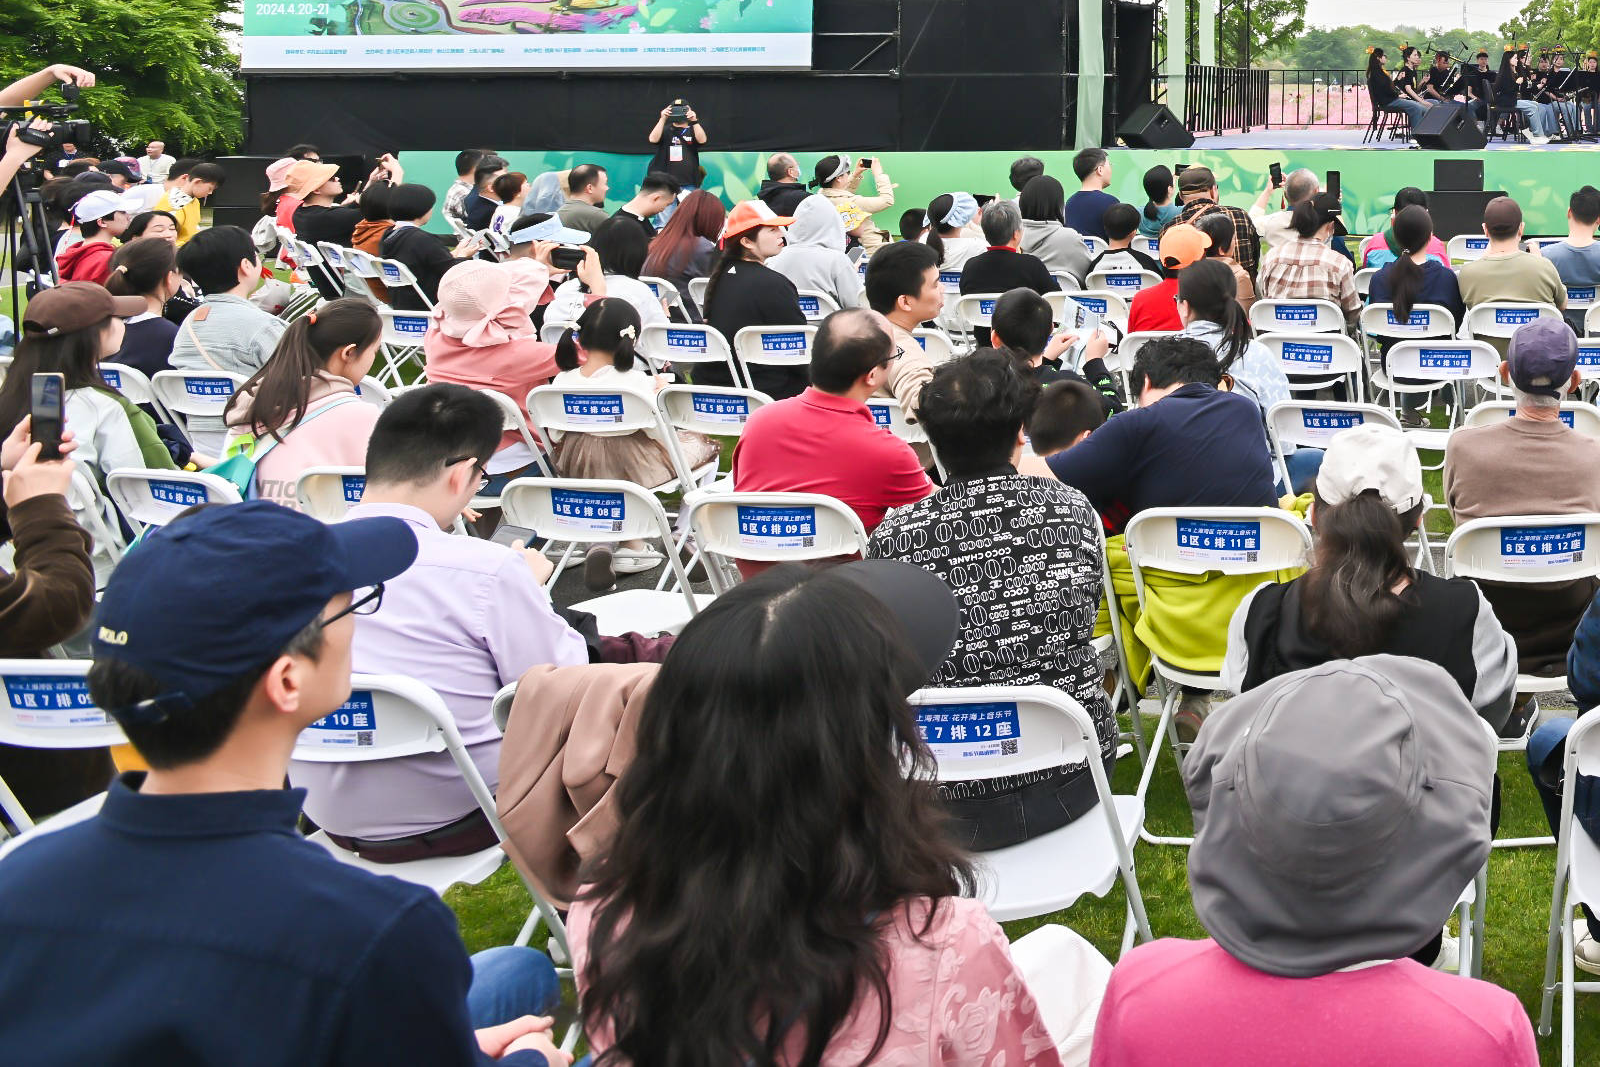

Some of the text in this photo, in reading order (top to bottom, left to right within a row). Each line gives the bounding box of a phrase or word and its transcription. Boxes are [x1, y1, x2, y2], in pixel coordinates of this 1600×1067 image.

[256, 3, 329, 14] 2024.4.20-21
[556, 504, 621, 517] B区6排08座
[743, 522, 812, 534] B区6排09座
[1181, 535, 1256, 549] B区6排11座
[1506, 539, 1581, 554] B区6排12座
